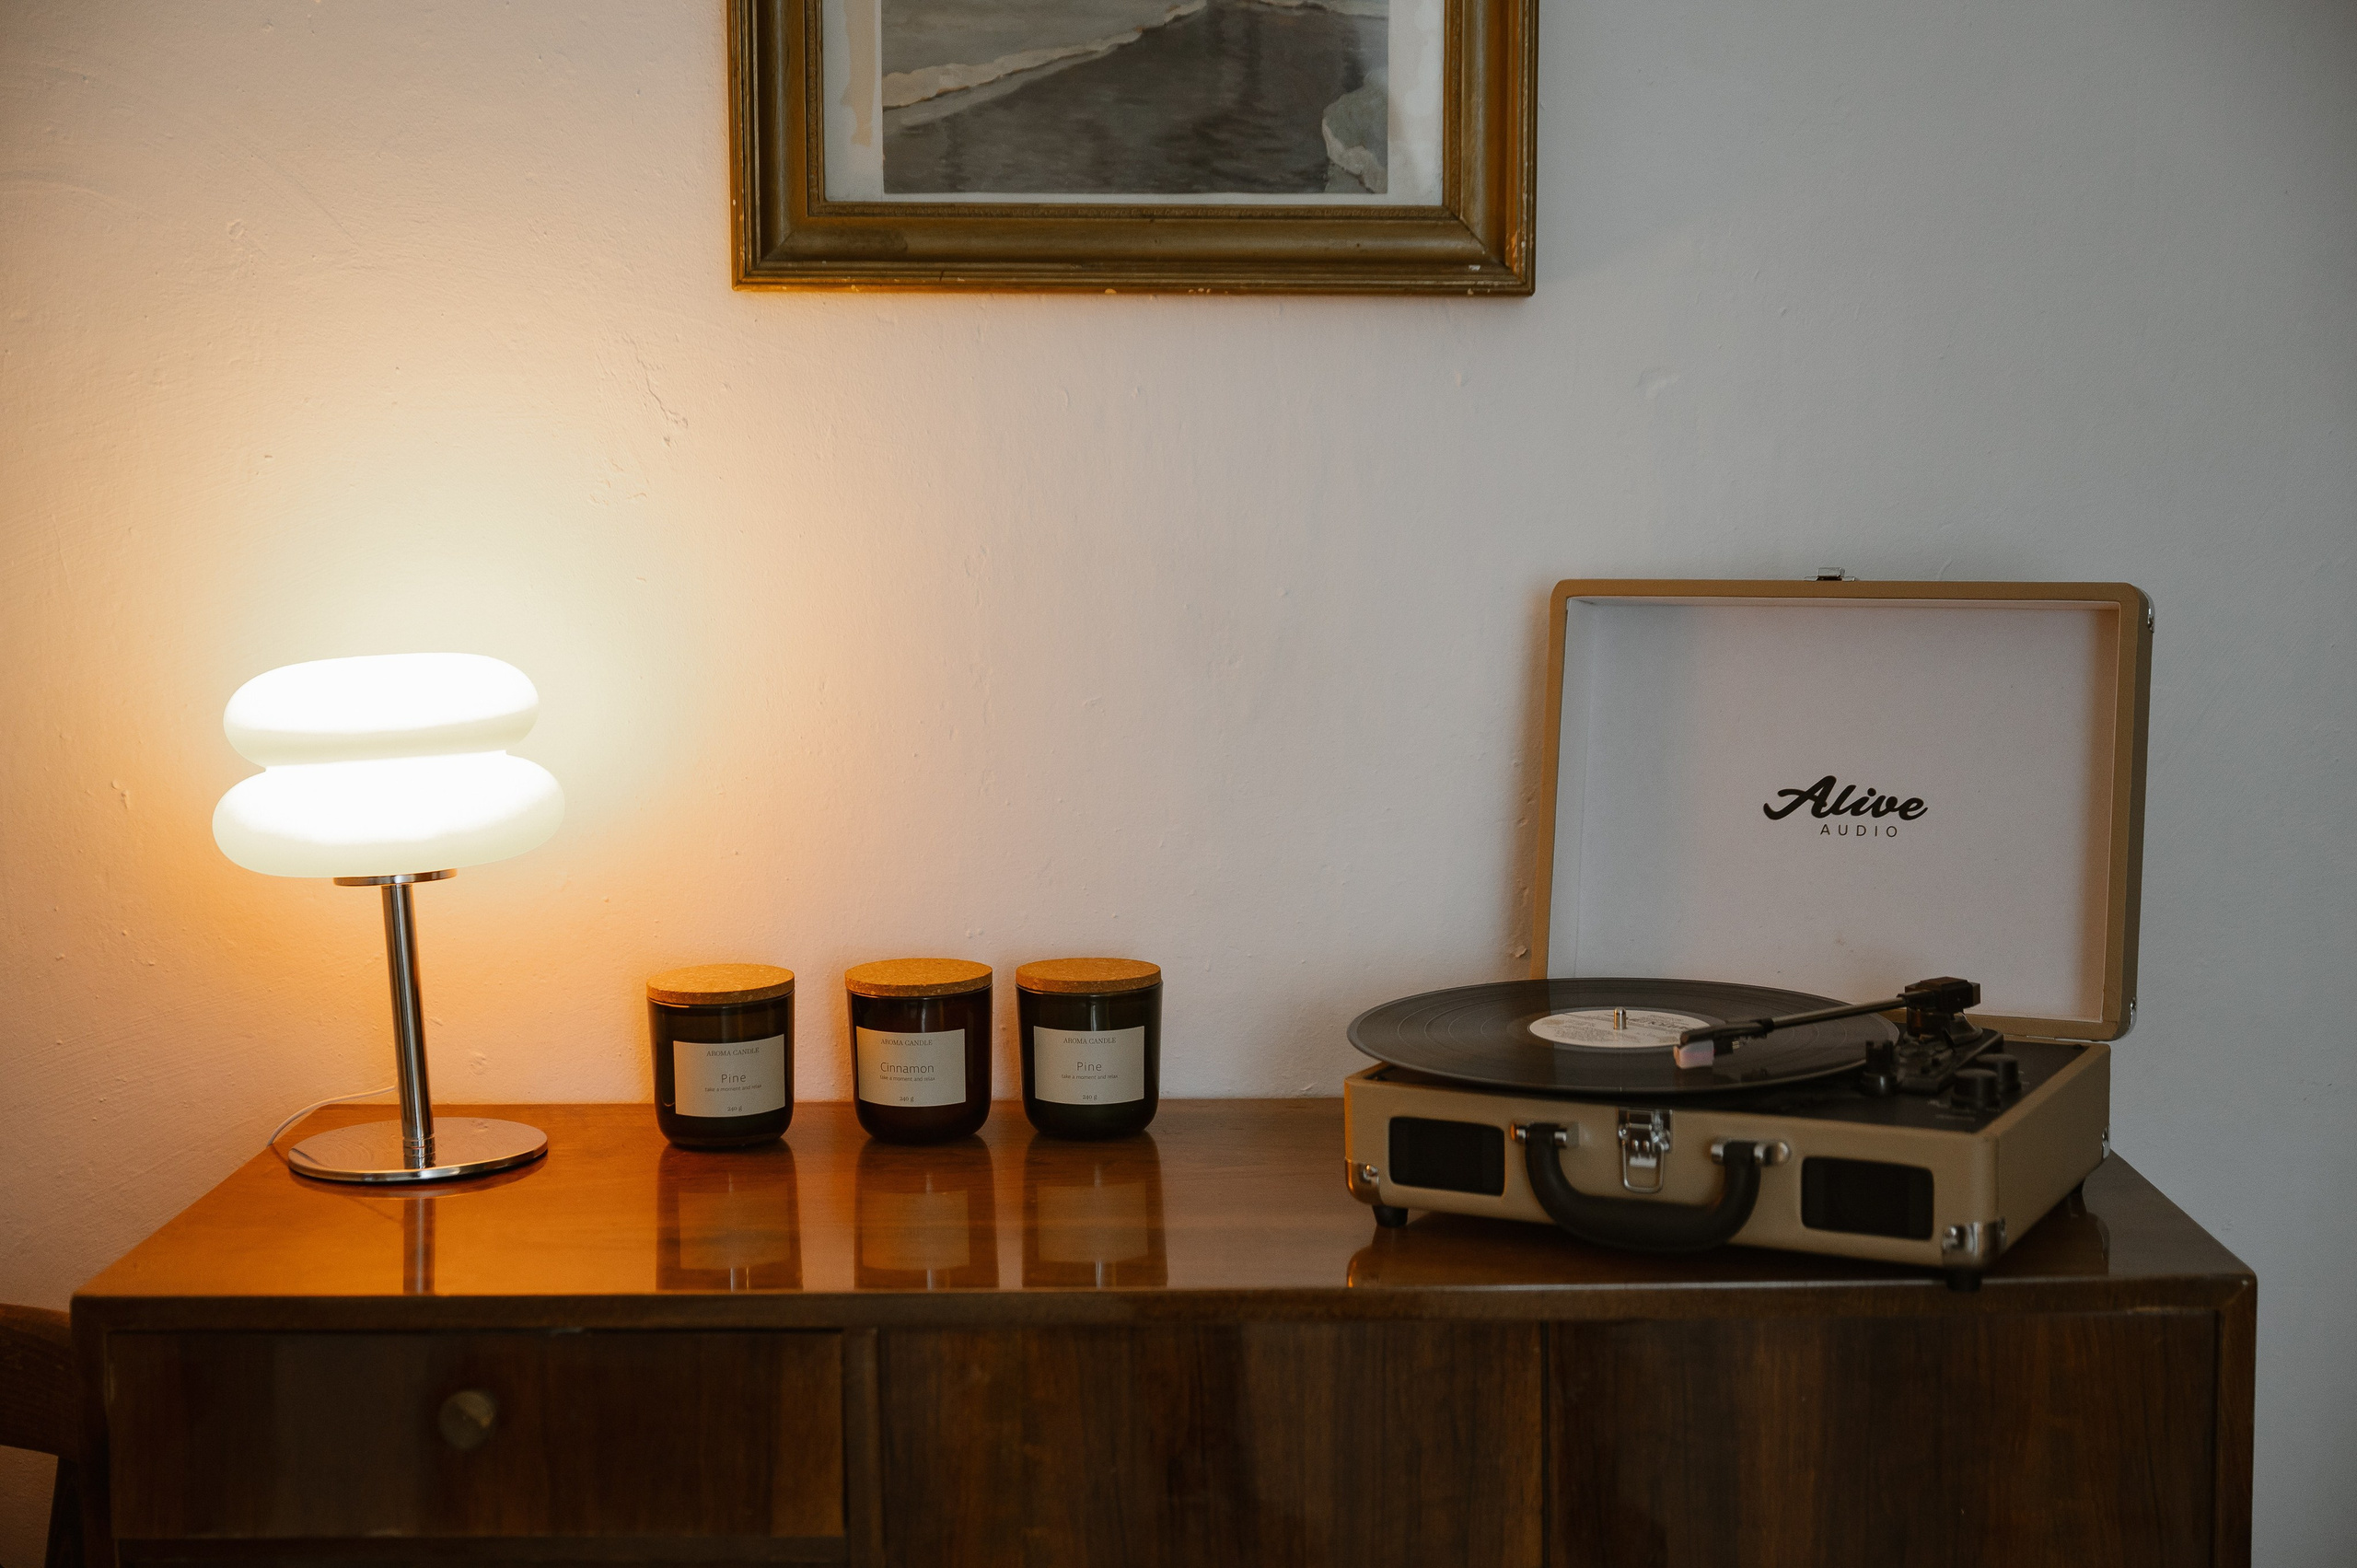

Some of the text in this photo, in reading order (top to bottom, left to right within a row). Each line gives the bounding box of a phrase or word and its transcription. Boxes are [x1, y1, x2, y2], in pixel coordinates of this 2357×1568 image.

[1763, 775, 1928, 820] Alive
[1820, 824, 1898, 837] AUDIO
[732, 1047, 760, 1056] CANDLE
[880, 1062, 935, 1074] Cinnamon
[1076, 1062, 1102, 1072] Pine
[721, 1074, 747, 1084] Pine
